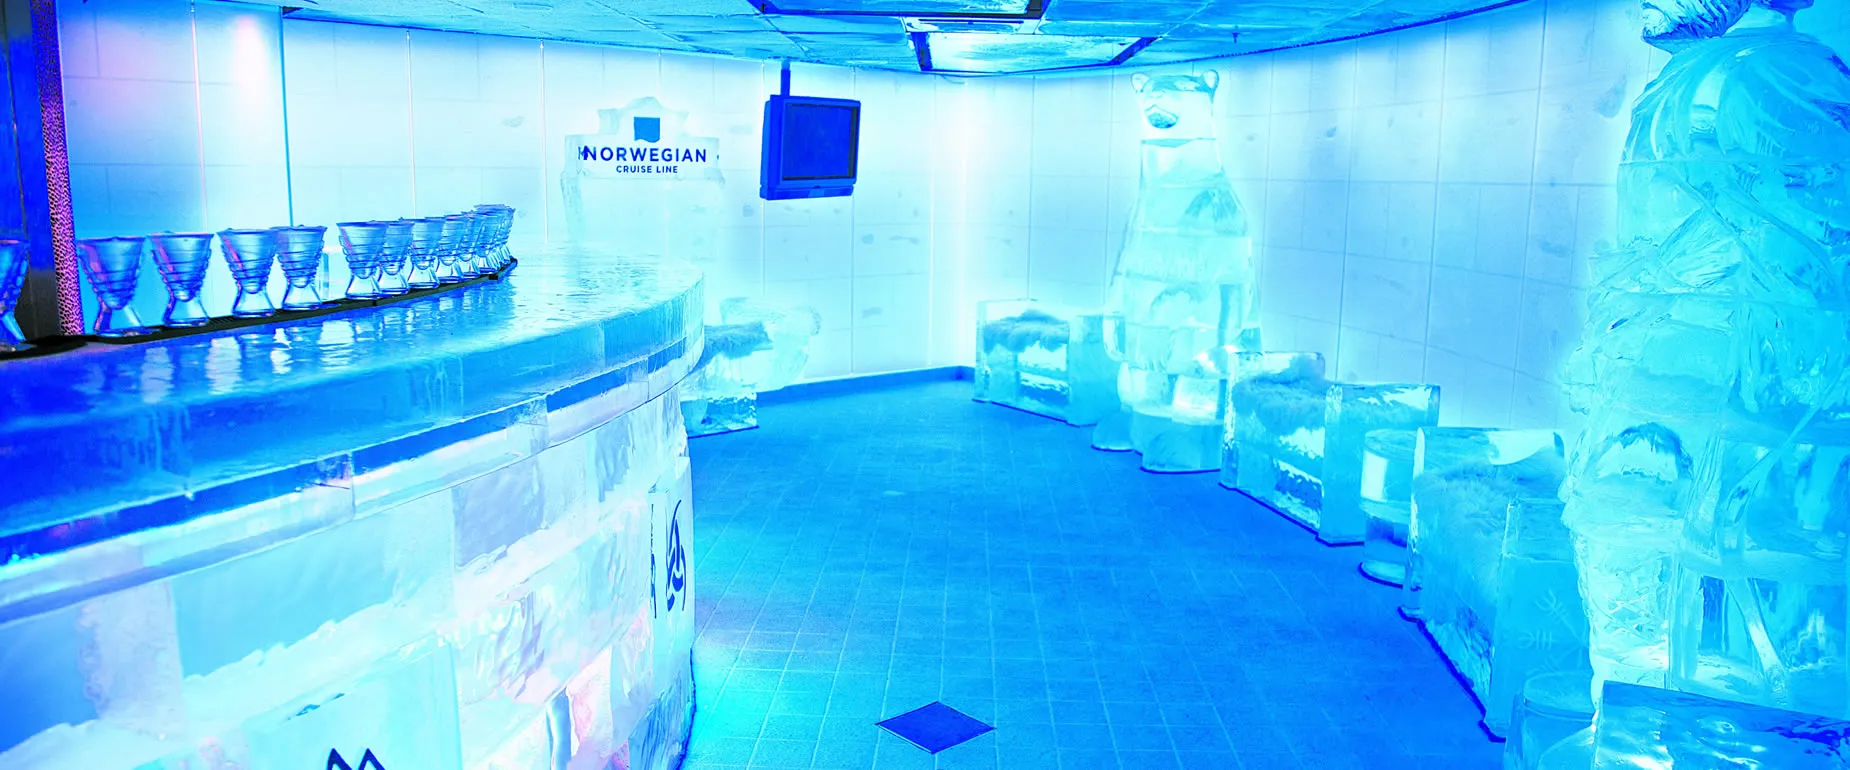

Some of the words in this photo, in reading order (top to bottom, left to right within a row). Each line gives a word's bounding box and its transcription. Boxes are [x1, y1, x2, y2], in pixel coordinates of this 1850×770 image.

[582, 145, 707, 162] NORWEGIAN
[615, 165, 653, 173] CRUISE
[656, 165, 678, 174] LINE
